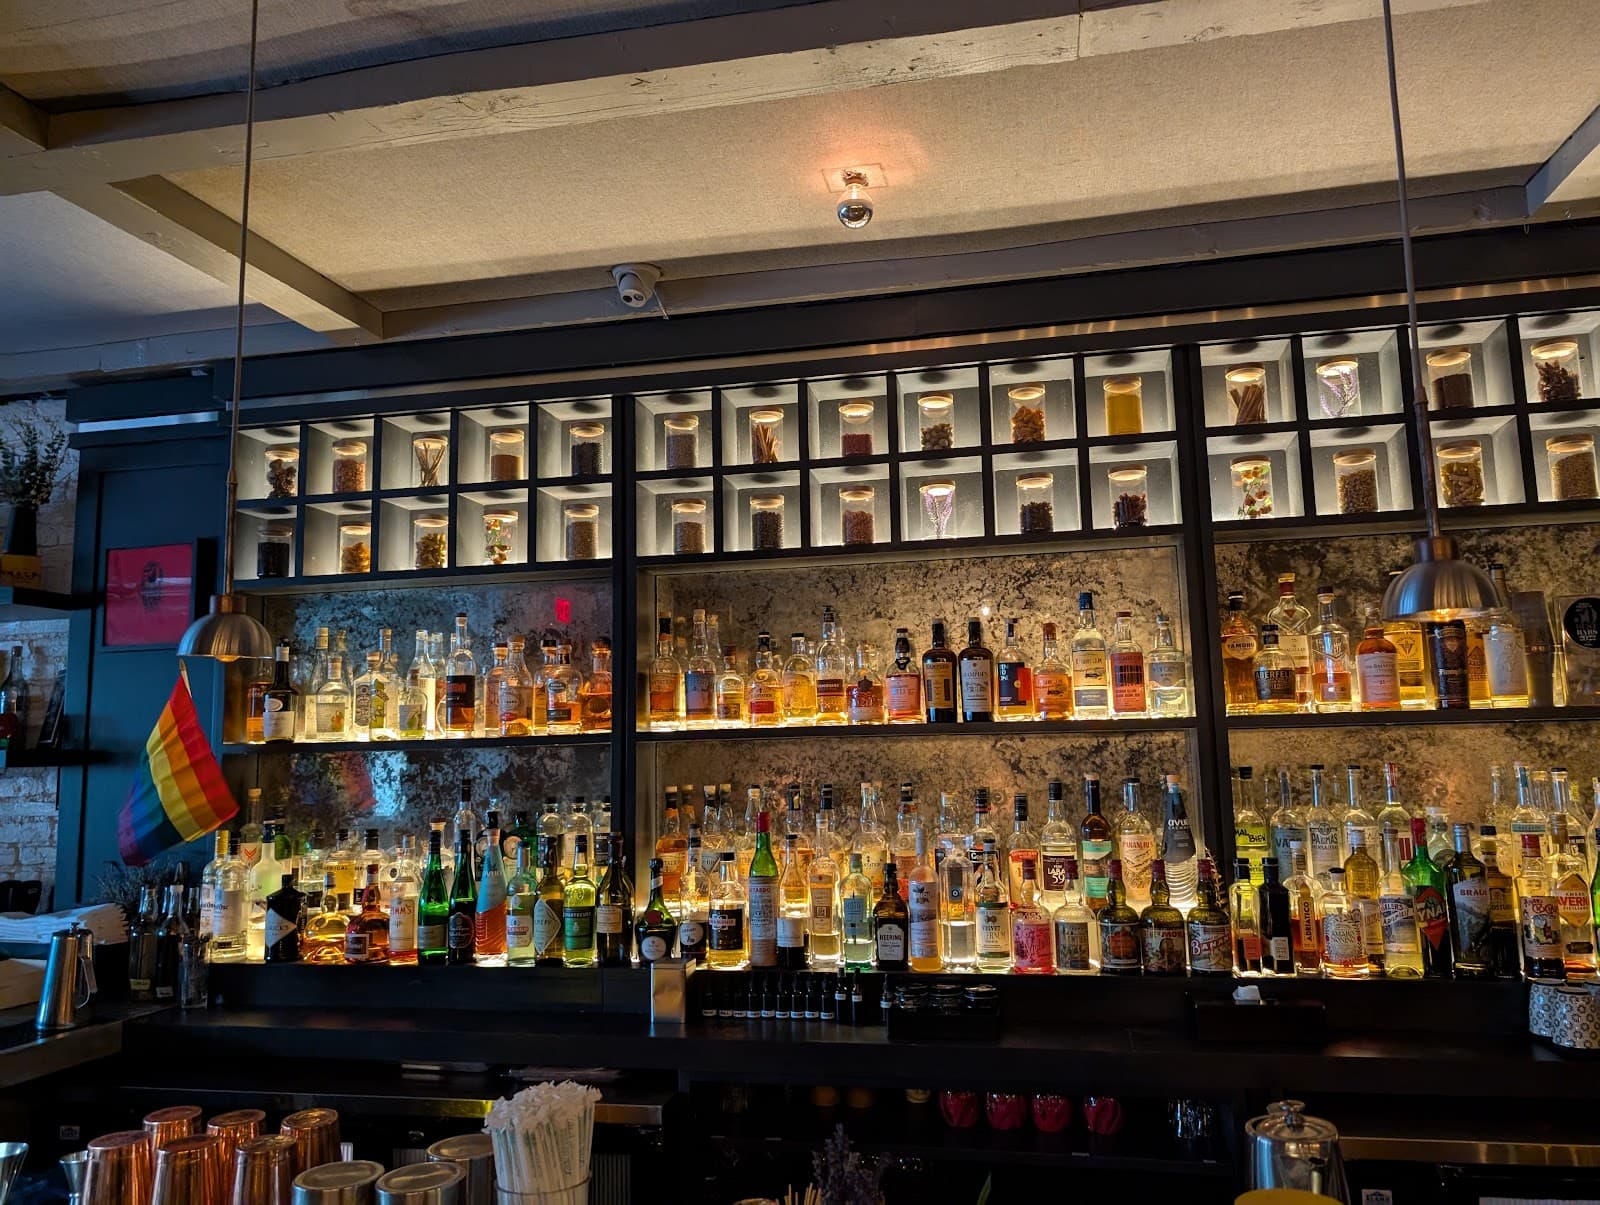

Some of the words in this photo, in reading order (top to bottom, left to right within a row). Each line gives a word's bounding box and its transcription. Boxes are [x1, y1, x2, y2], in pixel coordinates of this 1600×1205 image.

[1249, 834, 1266, 842] BIEN
[1051, 874, 1065, 885] 59
[1303, 901, 1312, 942] ADRIATICO
